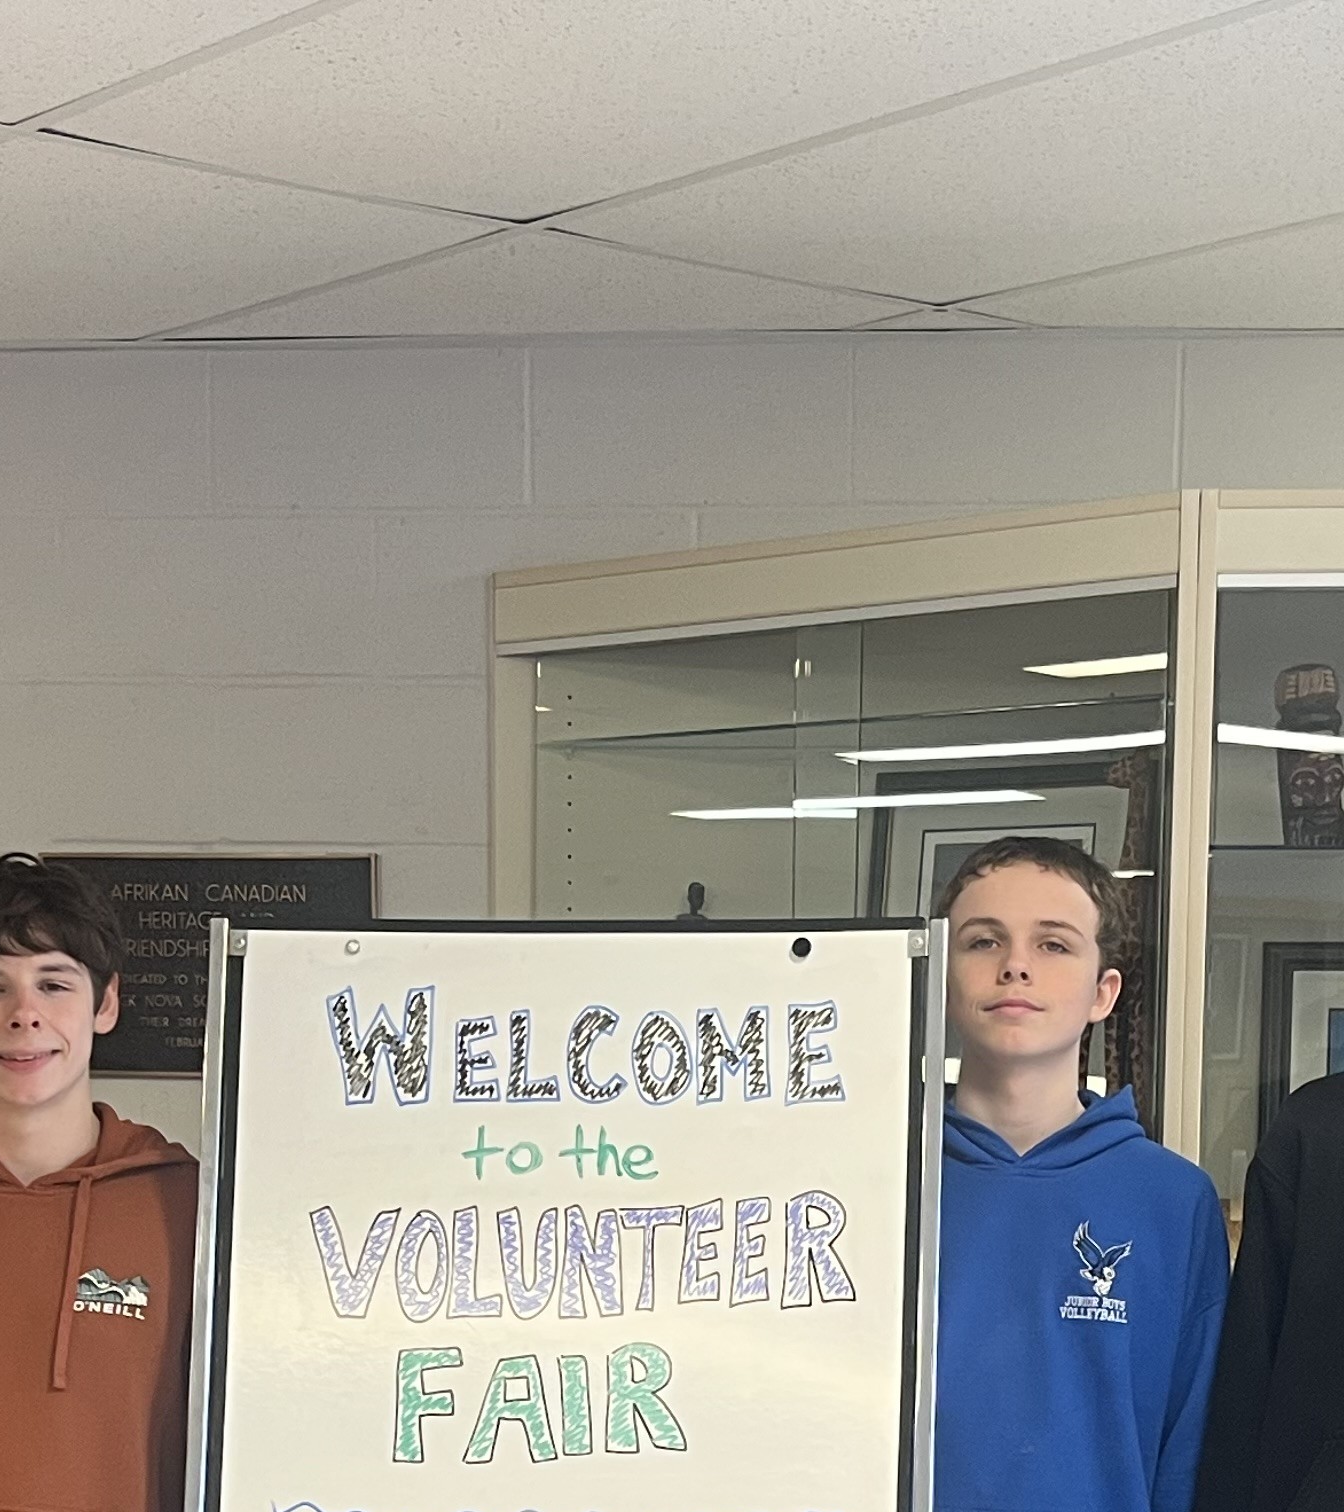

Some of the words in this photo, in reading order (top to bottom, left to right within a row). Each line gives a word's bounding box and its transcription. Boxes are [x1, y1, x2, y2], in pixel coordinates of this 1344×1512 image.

[111, 883, 189, 902] AFRIKAN
[206, 884, 307, 903] CANADIAN
[326, 985, 846, 1107] WELCOME
[461, 1125, 543, 1180] to
[558, 1124, 659, 1180] the
[308, 1190, 857, 1323] VOLUNTEER
[73, 1300, 146, 1320] O'NEILL
[1059, 1306, 1128, 1323] VOLLEYBALL
[1065, 1297, 1100, 1307] JUNIOR
[1102, 1298, 1126, 1311] BOYS
[392, 1342, 687, 1465] FAIR
